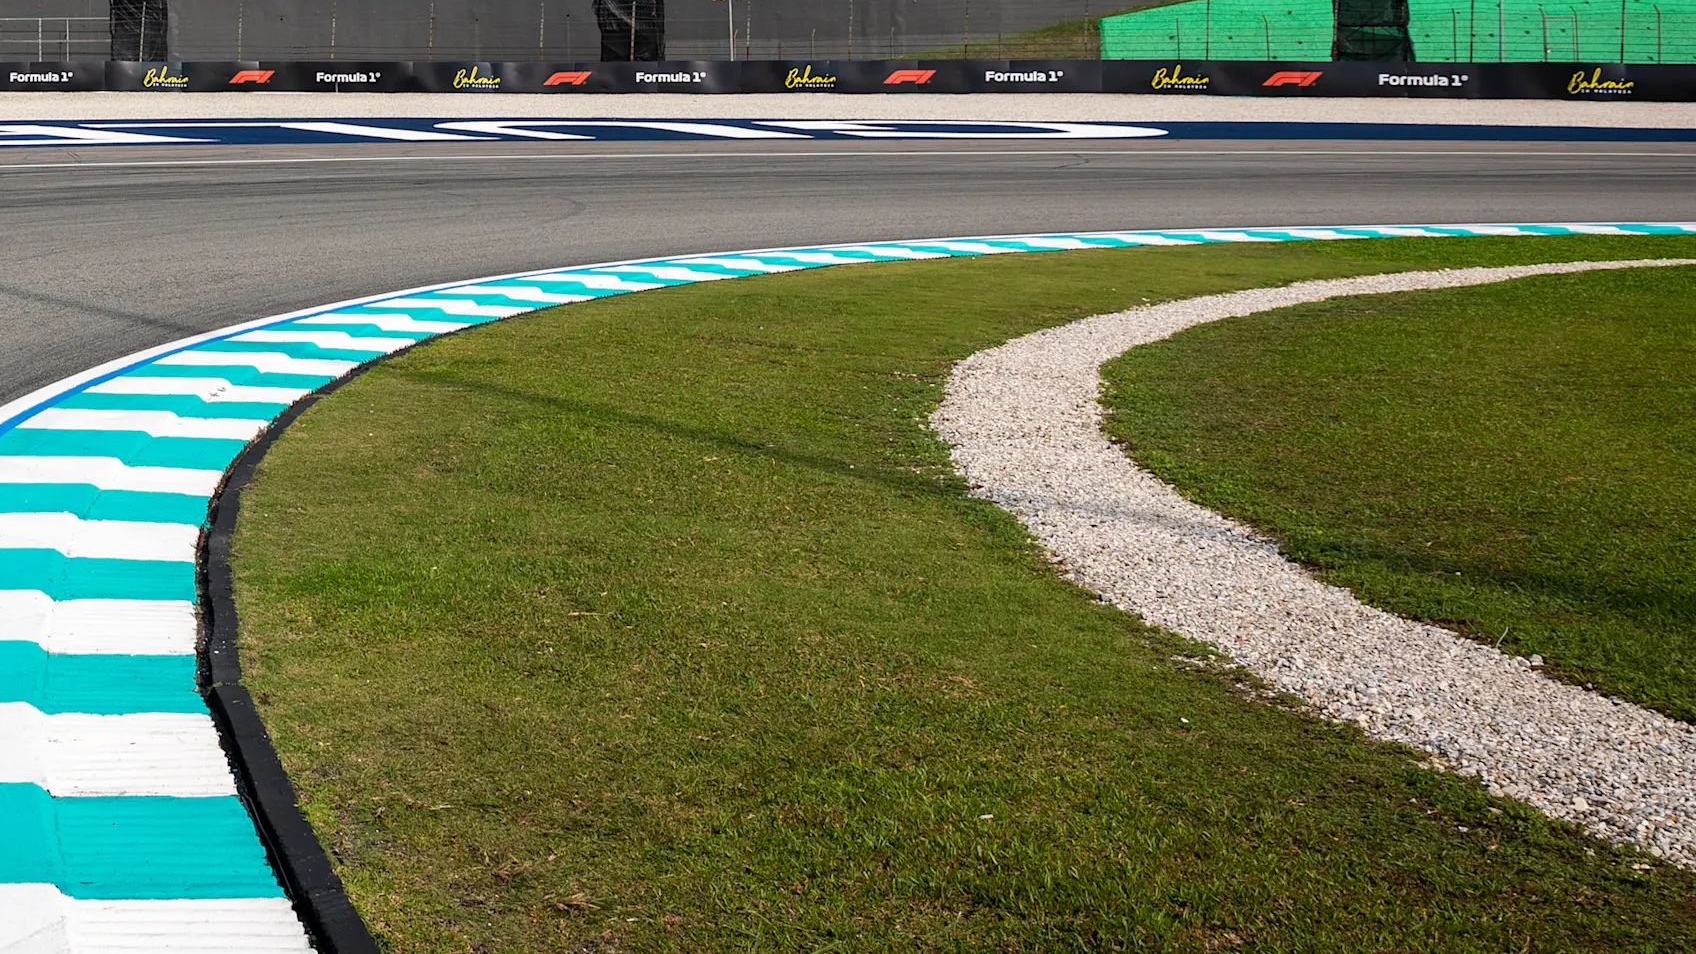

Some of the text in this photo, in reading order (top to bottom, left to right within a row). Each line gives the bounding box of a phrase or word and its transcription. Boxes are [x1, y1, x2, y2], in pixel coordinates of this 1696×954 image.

[9, 72, 59, 83] Formula
[144, 66, 190, 87] Bahrain
[229, 70, 275, 85] F1
[316, 72, 367, 83] Formula
[453, 67, 501, 88] Bahrain
[544, 71, 592, 86] F1
[635, 72, 690, 83] Formula
[784, 66, 837, 88] Bahrain
[883, 70, 937, 85] F1
[985, 71, 1046, 82] Formula
[1152, 64, 1210, 90] Bahrain
[1262, 72, 1323, 87] F1
[1378, 73, 1448, 87] Formula
[1567, 67, 1635, 94] Bahrain
